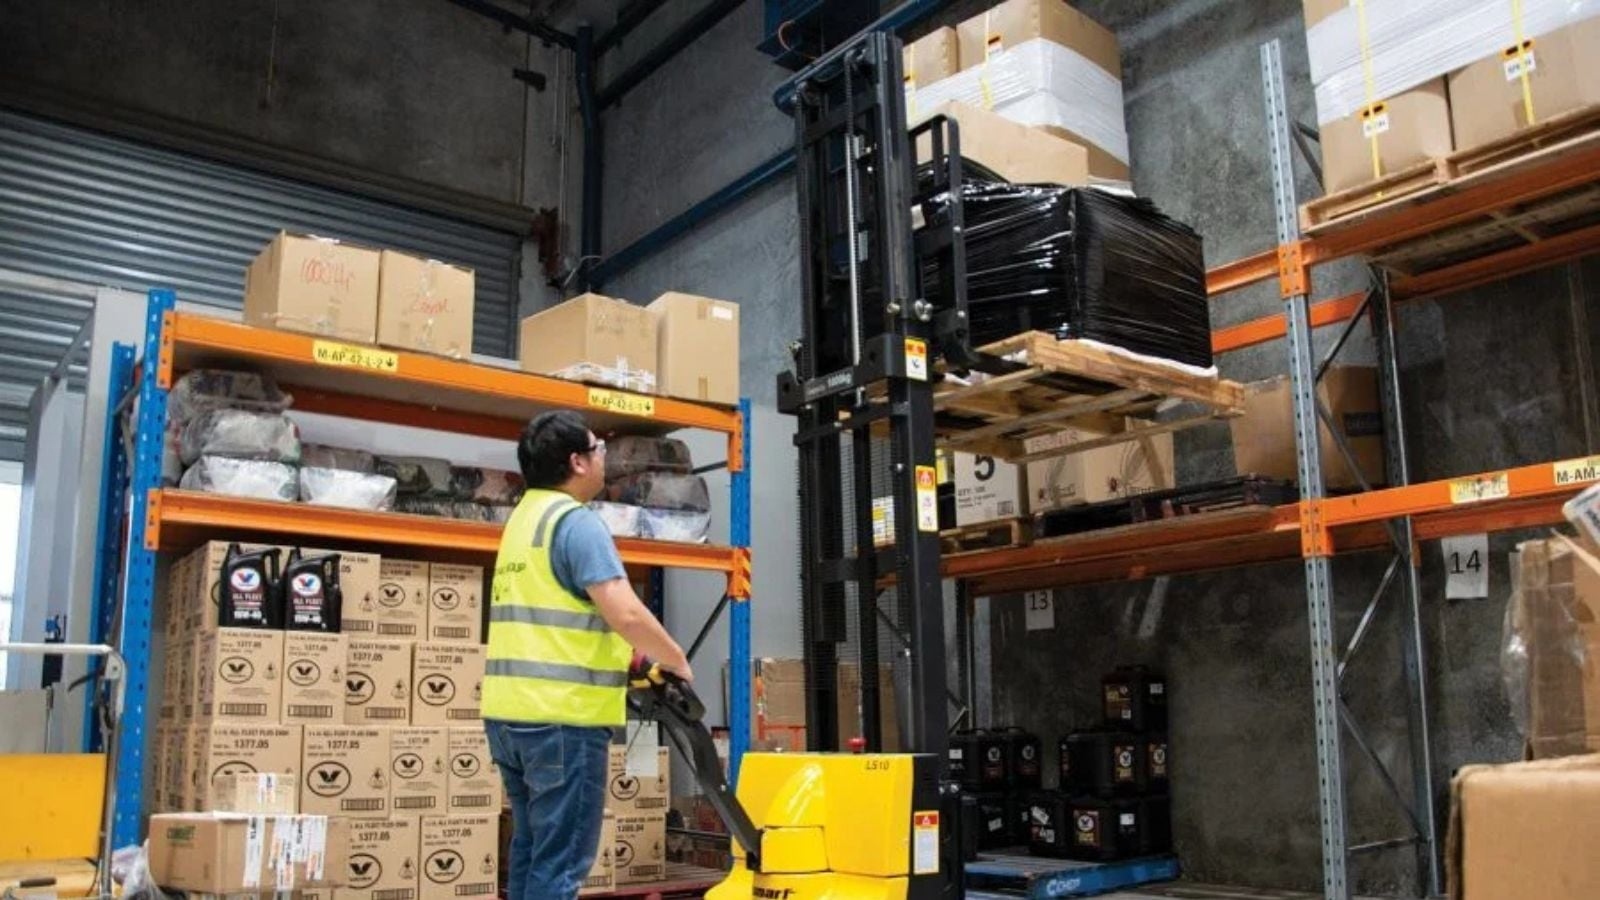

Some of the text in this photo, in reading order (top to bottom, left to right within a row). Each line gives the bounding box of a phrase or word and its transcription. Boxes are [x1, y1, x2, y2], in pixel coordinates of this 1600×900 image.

[974, 452, 995, 481] 5
[1450, 550, 1482, 574] 14
[1028, 591, 1048, 610] 13
[234, 739, 269, 749] 1377.05
